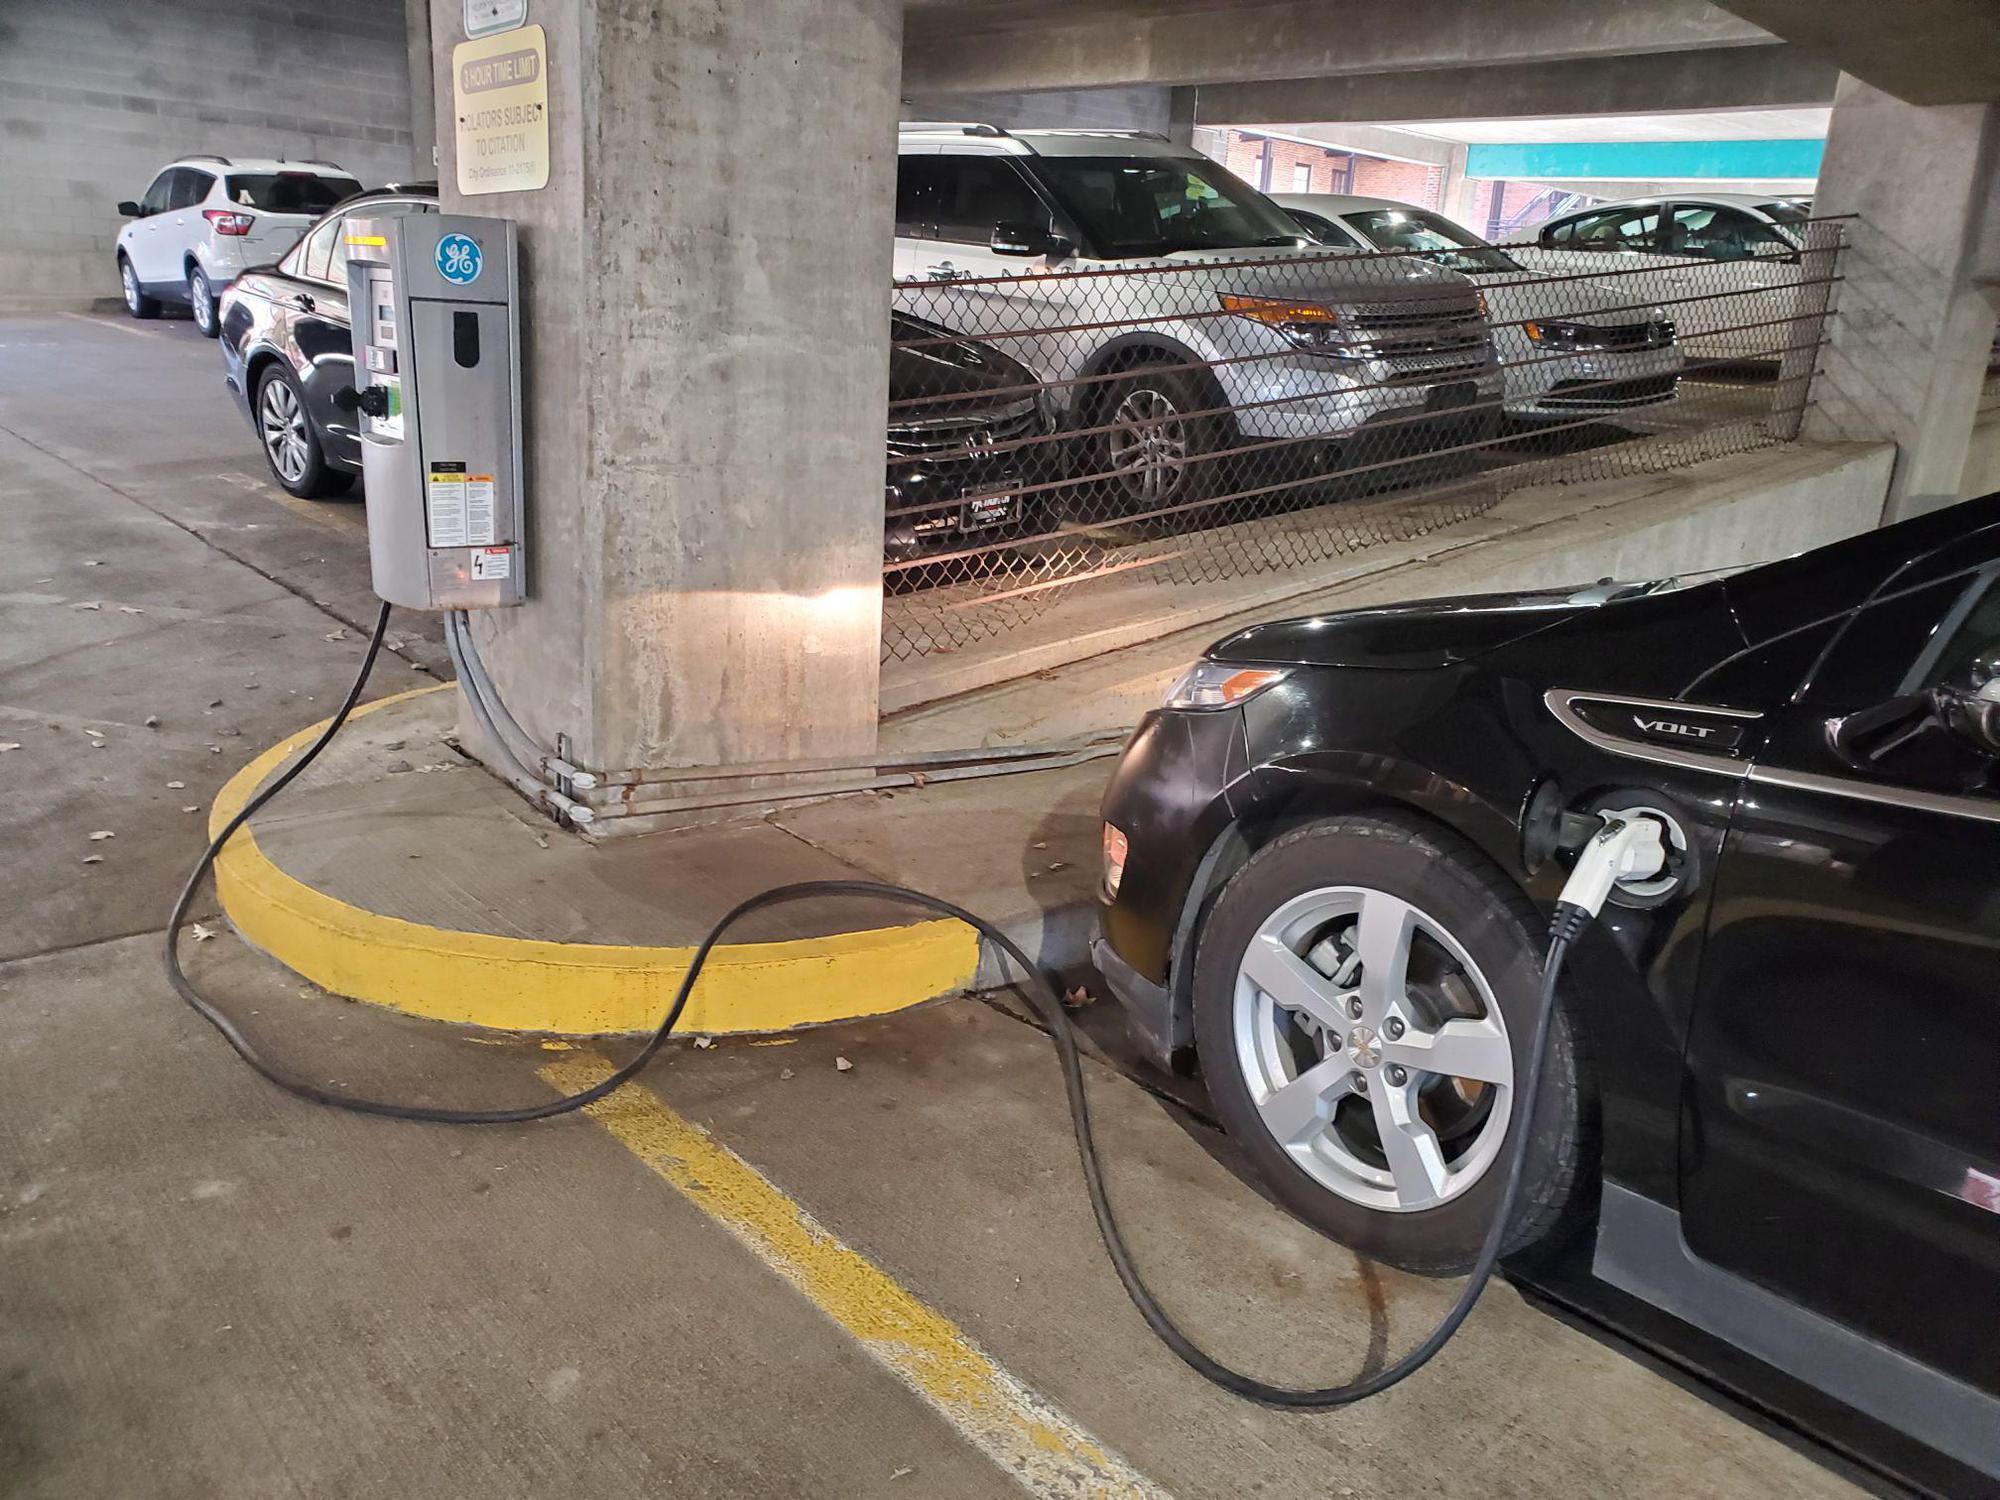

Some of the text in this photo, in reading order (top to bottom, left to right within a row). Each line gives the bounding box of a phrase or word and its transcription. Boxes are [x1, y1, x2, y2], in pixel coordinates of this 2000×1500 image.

[470, 62, 493, 87] HOUR
[493, 60, 513, 83] TIME
[514, 55, 537, 79] LIMIT
[476, 133, 526, 157] TO CITATION
[1633, 715, 1716, 738] VOLT
